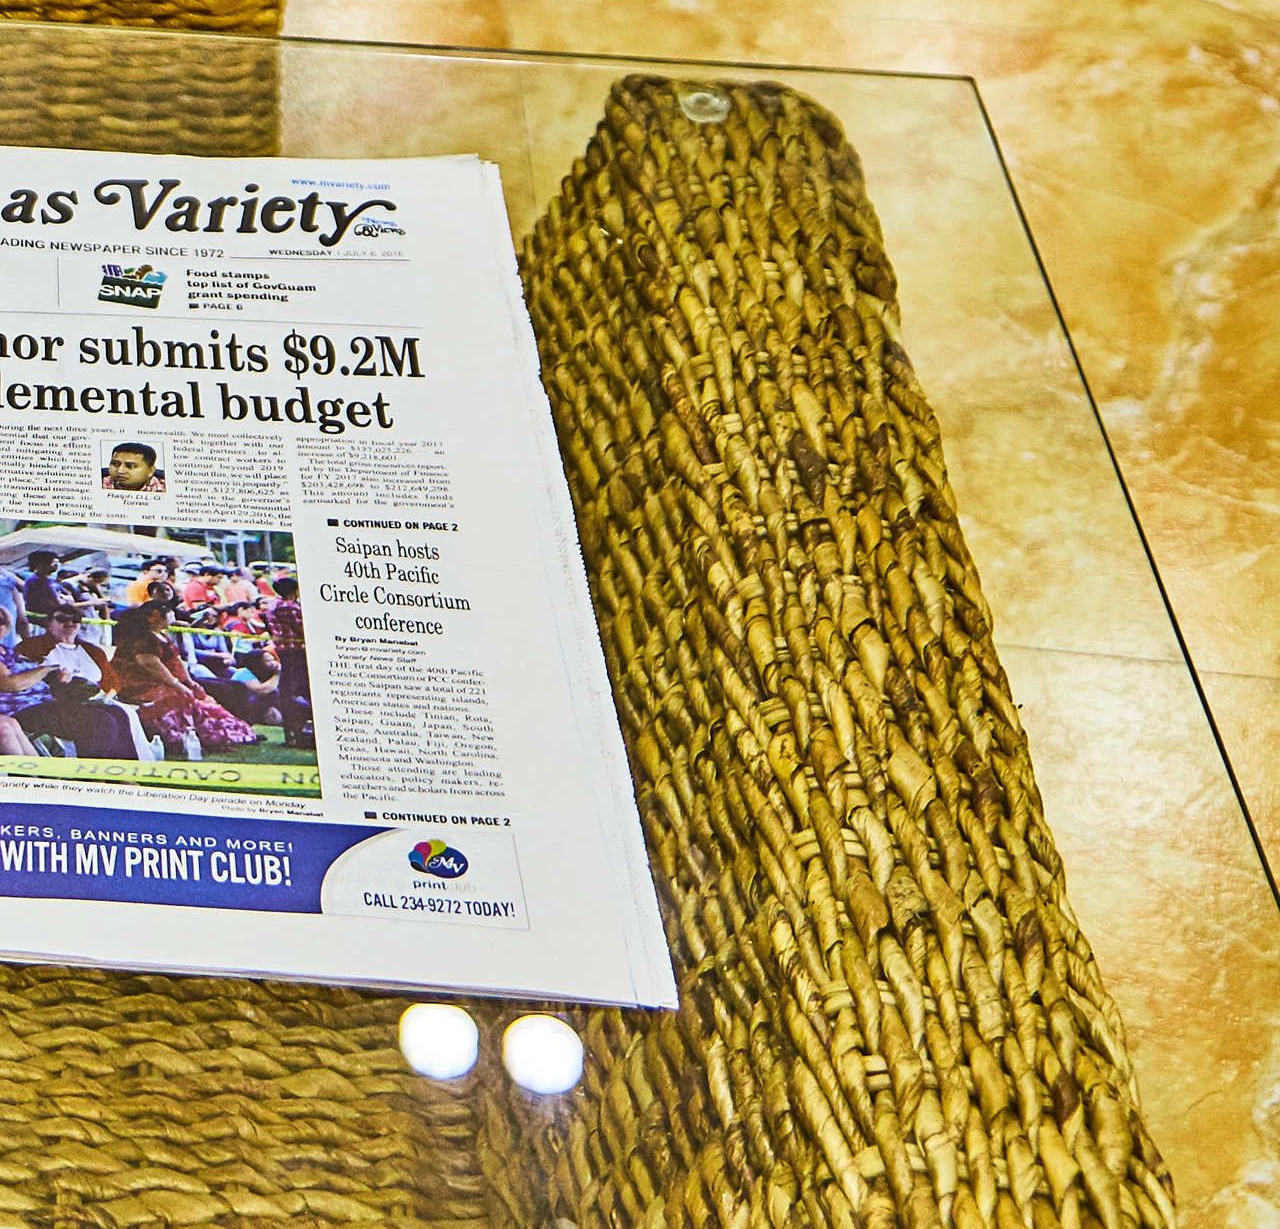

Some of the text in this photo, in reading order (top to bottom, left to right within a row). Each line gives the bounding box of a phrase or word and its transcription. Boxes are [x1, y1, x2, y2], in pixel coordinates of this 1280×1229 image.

[94, 179, 397, 247] Variety
[50, 241, 140, 255] NEWSPAPER
[145, 245, 188, 257] SINCE
[194, 247, 223, 259] 1972
[186, 268, 270, 281] Food stamps
[99, 285, 162, 299] SNAP
[187, 280, 317, 293] top list of GovGuam
[188, 291, 289, 303] grant spending
[79, 326, 269, 373] submits
[284, 328, 425, 381] $9.2M
[217, 382, 393, 435] budget
[343, 520, 458, 531] CONTINUED ON PAGE 2
[335, 537, 440, 560] Saipan hosts
[343, 561, 440, 584] 40th Pacific
[319, 583, 471, 610] Circle Consortium
[355, 612, 444, 635] conference
[382, 812, 511, 827] CONTINUED ON PAGE 2
[70, 829, 167, 845] BANNERS
[176, 835, 217, 847] AND
[226, 839, 293, 853] MORE!
[0, 839, 68, 873] WITH
[75, 844, 118, 877] MV
[125, 847, 204, 881] PRINT
[211, 851, 292, 886] CLUB!
[429, 856, 464, 873] MV
[363, 892, 515, 918] CALL 234-9272 TODAY!
